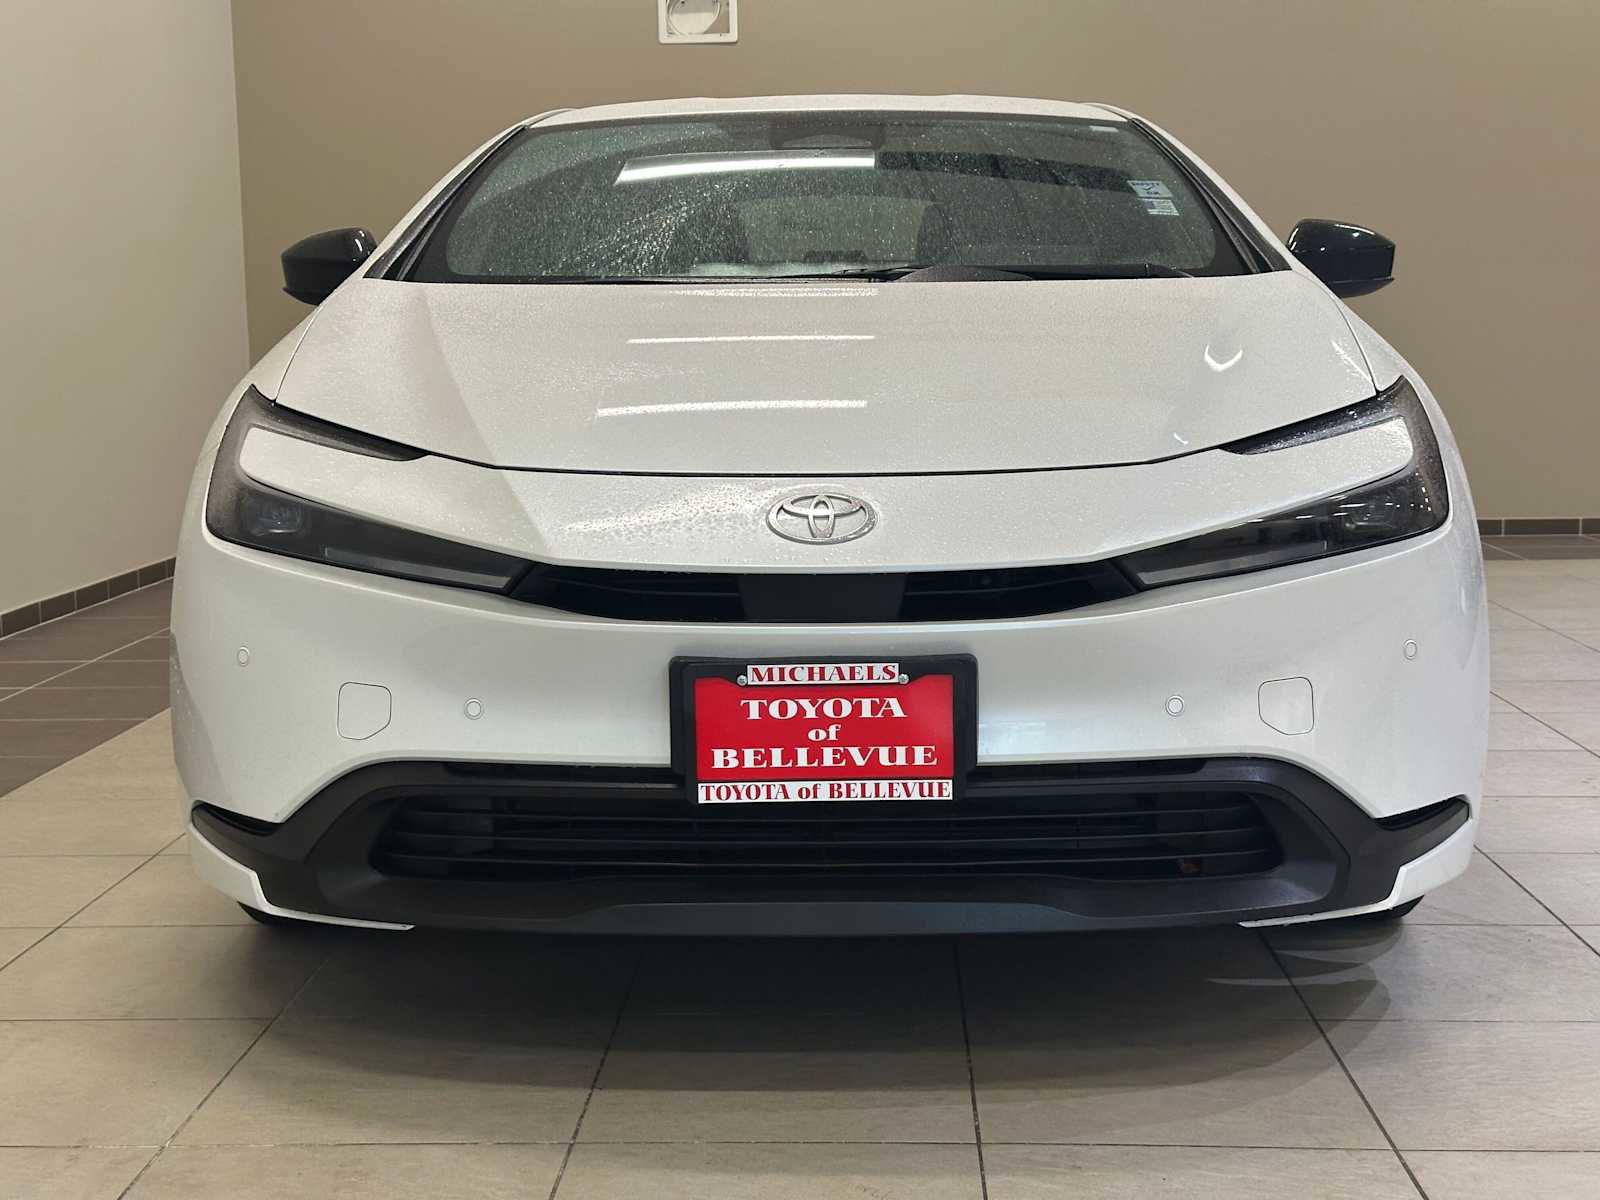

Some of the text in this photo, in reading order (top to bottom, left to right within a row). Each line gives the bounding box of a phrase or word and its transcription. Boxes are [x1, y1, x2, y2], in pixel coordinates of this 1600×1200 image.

[752, 665, 896, 682] MICHAELS
[741, 697, 907, 720] TOYOTA
[808, 724, 841, 741] of
[712, 745, 938, 769] BELLEVUE
[700, 780, 950, 801] TOYOTA of BELLEVUE
